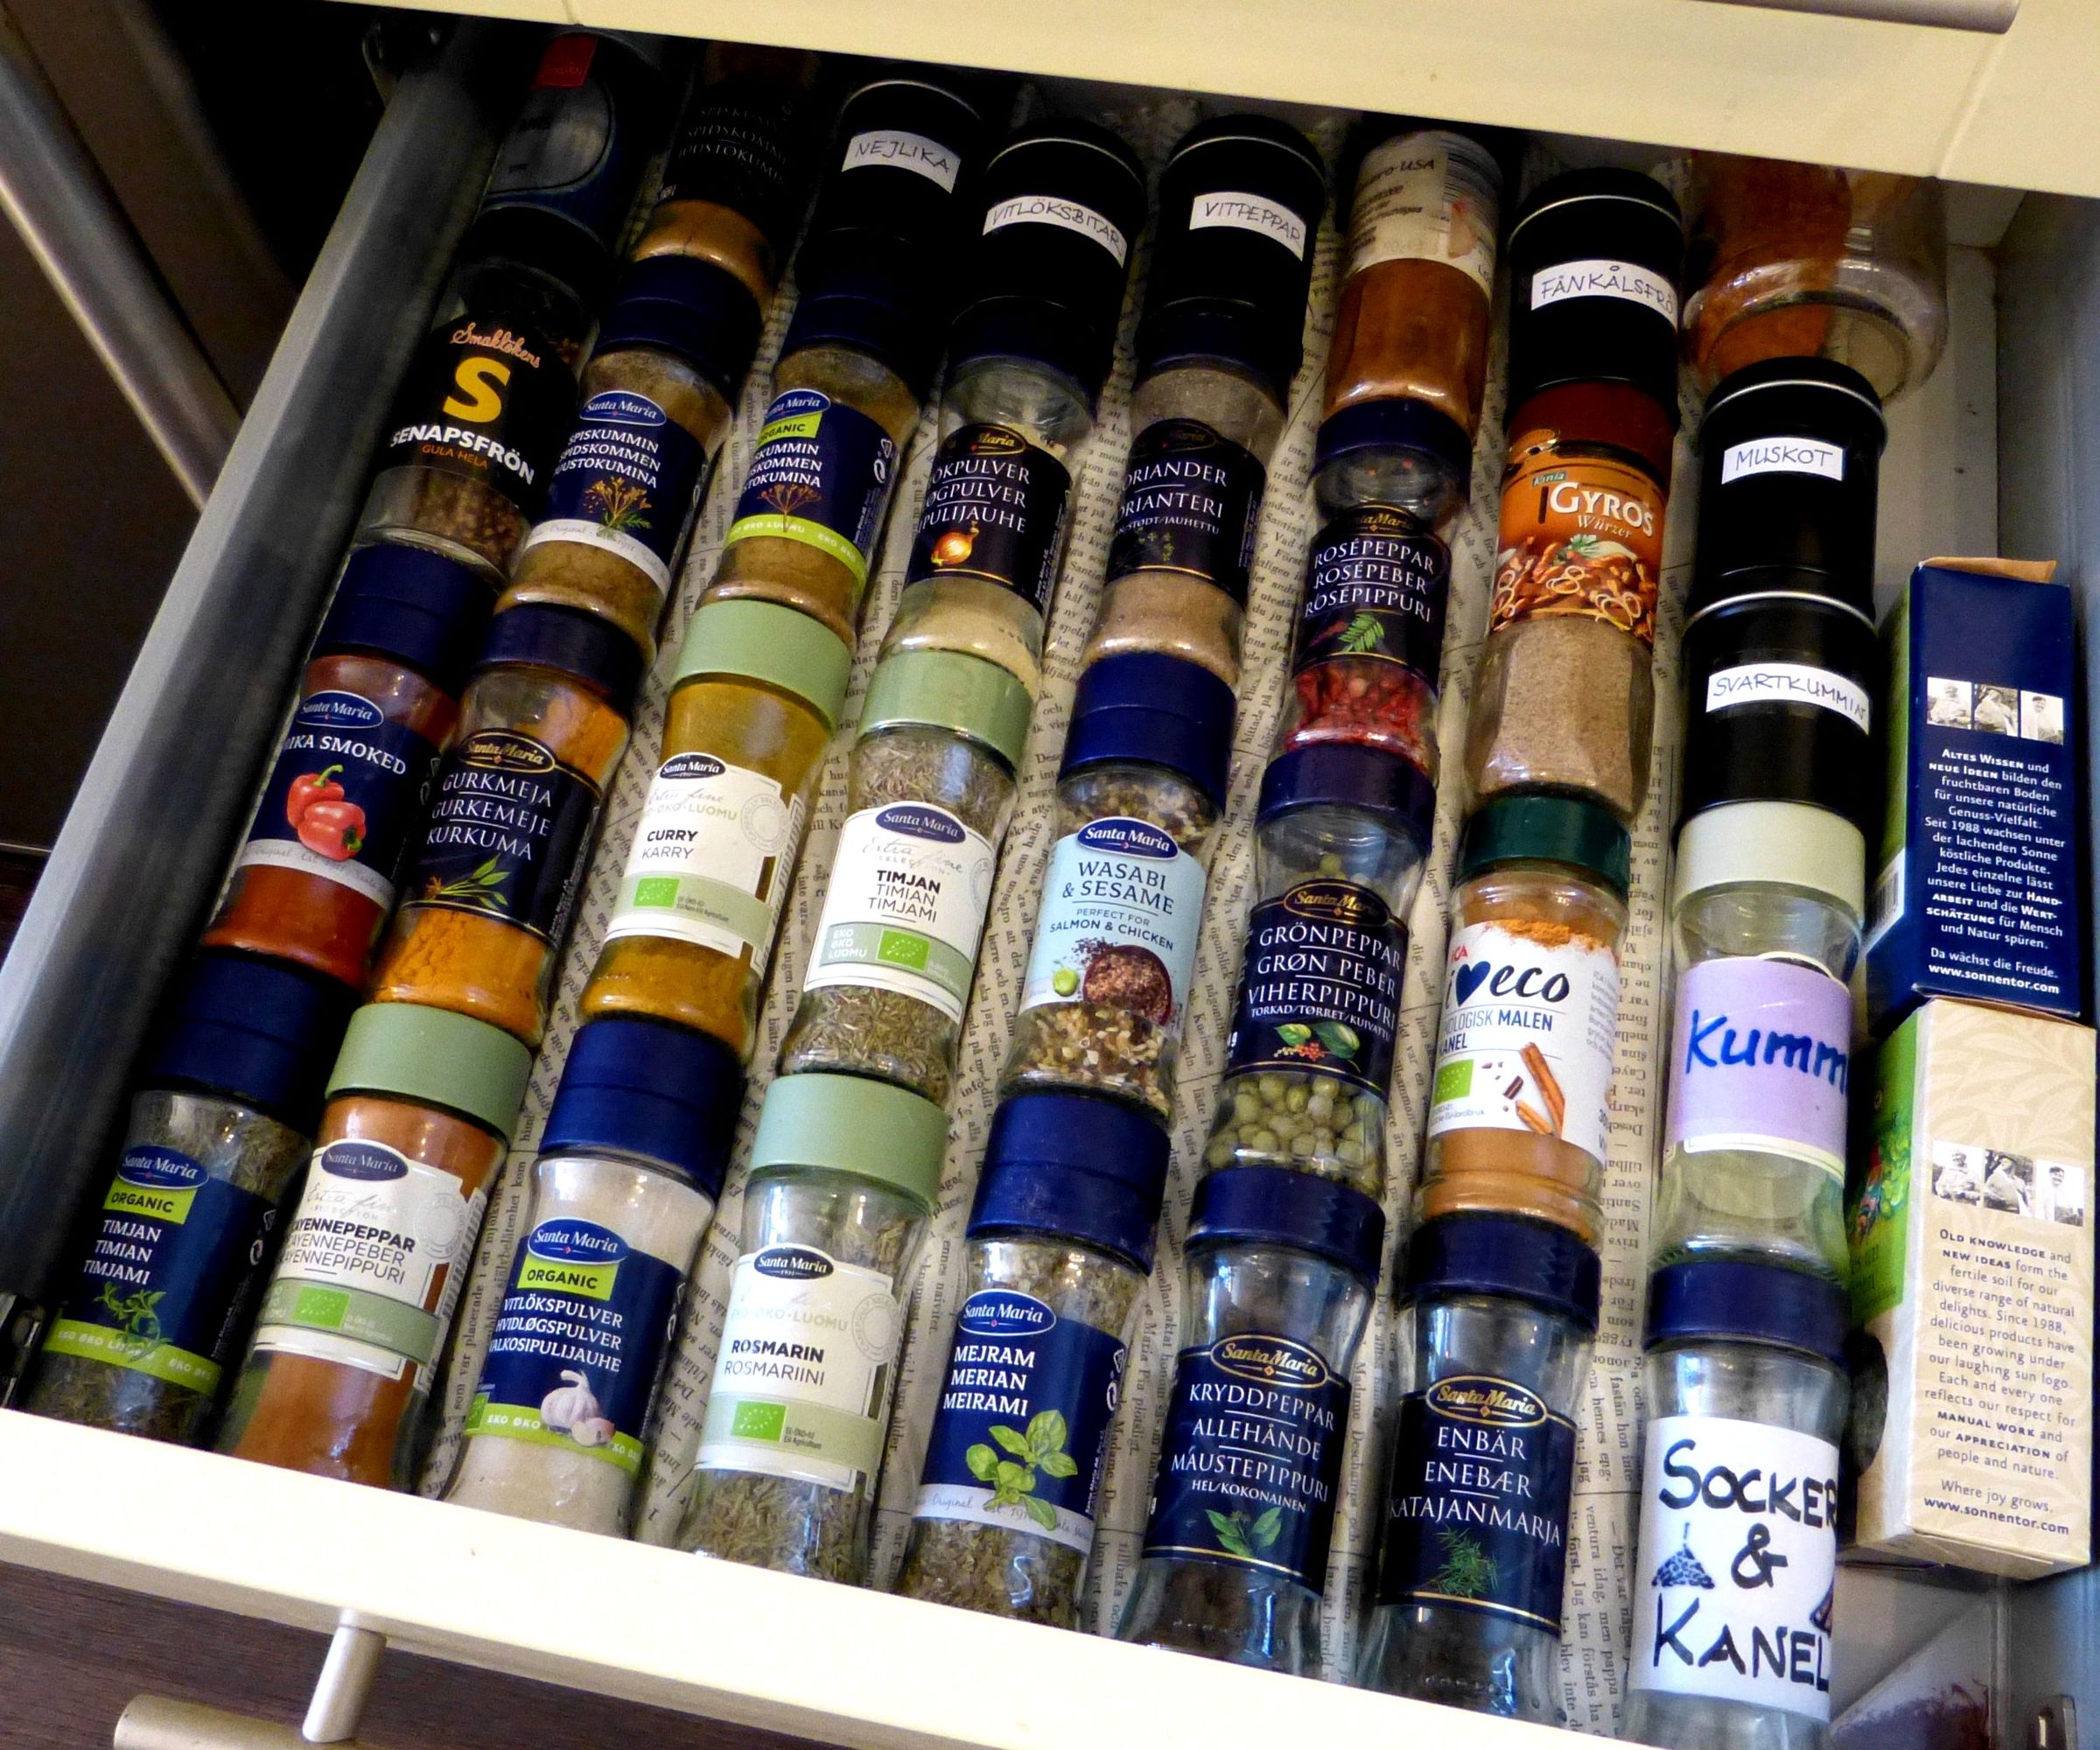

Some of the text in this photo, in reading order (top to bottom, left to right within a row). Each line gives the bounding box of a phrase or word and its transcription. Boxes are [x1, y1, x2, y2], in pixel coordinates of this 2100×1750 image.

[855, 140, 950, 173] NEJLIKA
[992, 198, 1123, 256] VITLÖKSBITAR
[1206, 201, 1303, 250] VITPEPPAR
[1542, 265, 1672, 314] FÄNKÅLSFRÖ
[450, 322, 541, 368] Smaklökens
[443, 357, 511, 423] S
[787, 396, 821, 408] Maria
[585, 400, 657, 419] Santa Maria
[390, 425, 535, 485] SENAPSFRÖN
[568, 429, 659, 453] SPISKUMMIN
[422, 444, 487, 469] GULA HELA
[1736, 446, 1833, 471] MUSKOT
[1550, 481, 1654, 538] GYROS
[1314, 539, 1434, 574] ROSÉPEPPAR
[1314, 561, 1427, 594] ROSÉPEBER
[1305, 584, 1431, 623] ROSÉPIPPURI
[332, 702, 372, 720] Maria
[1712, 673, 1866, 720] SVARTKUMMIN
[319, 736, 407, 775] SMOKED
[688, 761, 720, 774] Maria
[1942, 749, 2049, 773] ALTES WISSEN und
[443, 773, 552, 808] GURKMEJA
[1942, 776, 2049, 802] fruchtbaren Boden
[1964, 766, 1998, 779] IDEEN
[2002, 771, 2037, 785] bilden
[2041, 778, 2062, 790] den
[431, 799, 551, 836] GURKEMEJE
[1935, 788, 2056, 817] für unsere natürliche
[1949, 806, 2042, 829] Genuss-Vielfalt.
[647, 830, 698, 843] CURRY
[884, 812, 959, 837] Santa Maria
[1085, 828, 1170, 851] Santa Maria
[1925, 817, 2065, 848] Seit 1988 wachsen unter
[427, 826, 532, 861] KURKUMA
[641, 846, 694, 859] KARRY
[1079, 861, 1166, 890] WASABI
[1936, 862, 2054, 890] Jedes einzelne lässt
[1940, 848, 2051, 874] köstliche Produkte.
[877, 870, 942, 894] TIMJAN
[877, 884, 935, 907] TIMIAN
[1928, 878, 2062, 906] unsere Liebe zur HAND-
[868, 897, 936, 923] TIMJAMI
[1063, 880, 1174, 915] & SESAME
[1932, 893, 2057, 920] ARBEIT und die WERT-
[1076, 908, 1151, 927] PERFECT FOR
[1927, 907, 2063, 936] SCHÄTZUNG für Mensch
[1050, 920, 1173, 950] SALMON & CHICKEN
[1260, 921, 1400, 971] GRÖNPEPPAR
[1941, 923, 2048, 949] und Natur spüren.
[1257, 953, 1396, 999] GRØN PEBER
[1931, 948, 2058, 978] Da wächst die Freude.
[1489, 964, 1570, 1003] eco
[1928, 964, 2059, 994] www.sonnentor.com
[1249, 983, 1395, 1030] VIHERPIPPURI
[1498, 1009, 1552, 1032] MALEN
[154, 1157, 198, 1180] Maria
[326, 1152, 397, 1172] Santa Maria
[111, 1192, 173, 1213] ORGANIC
[102, 1220, 162, 1242] TIMJAN
[534, 1228, 620, 1253] Santa Maria
[1940, 1228, 2071, 1264] OLD KNOWLEDGE and
[94, 1239, 152, 1264] TIMIAN
[758, 1256, 828, 1274] Santa Maria
[1942, 1250, 2068, 1280] NEW IDEAS form the
[84, 1260, 150, 1284] TIMJAMI
[527, 1269, 598, 1290] ORGANIC
[504, 1293, 623, 1328] VITLÖKSPULVER
[963, 1304, 1043, 1323] Santa Maria
[496, 1317, 621, 1350] HVIDLØGSPULVER
[732, 1340, 824, 1363] ROSMARIN
[955, 1346, 1036, 1368] MEJRAM
[1222, 1343, 1319, 1376] Santa Maria
[724, 1361, 824, 1386] ROSMARIINI
[951, 1368, 1026, 1391] MERIAN
[943, 1392, 1028, 1417] MEIRAMI
[1189, 1383, 1334, 1432] KRYDDPEPPAR
[1437, 1385, 1536, 1415] Santa Maria
[1592, 1397, 1606, 1444] hennes
[1937, 1411, 2062, 1442] MANUAL WORK and
[1192, 1418, 1320, 1461] ALLEHÅNDE
[1438, 1426, 1526, 1460] ENBÄR
[1930, 1427, 2068, 1462] our APPRECIATION of
[1424, 1460, 1532, 1498] ENEBÆR
[1192, 1480, 1306, 1513] HEL/KOKONAINEN
[1942, 1479, 2053, 1513] Where joy grows.
[1390, 1496, 1561, 1547] KATAJANMARJA
[1924, 1498, 2069, 1535] www.sonnentor.com
[1731, 1522, 1788, 1589] &
[1586, 1505, 1618, 1695] ventura pappa
[1653, 1592, 1829, 1693] KANEL
